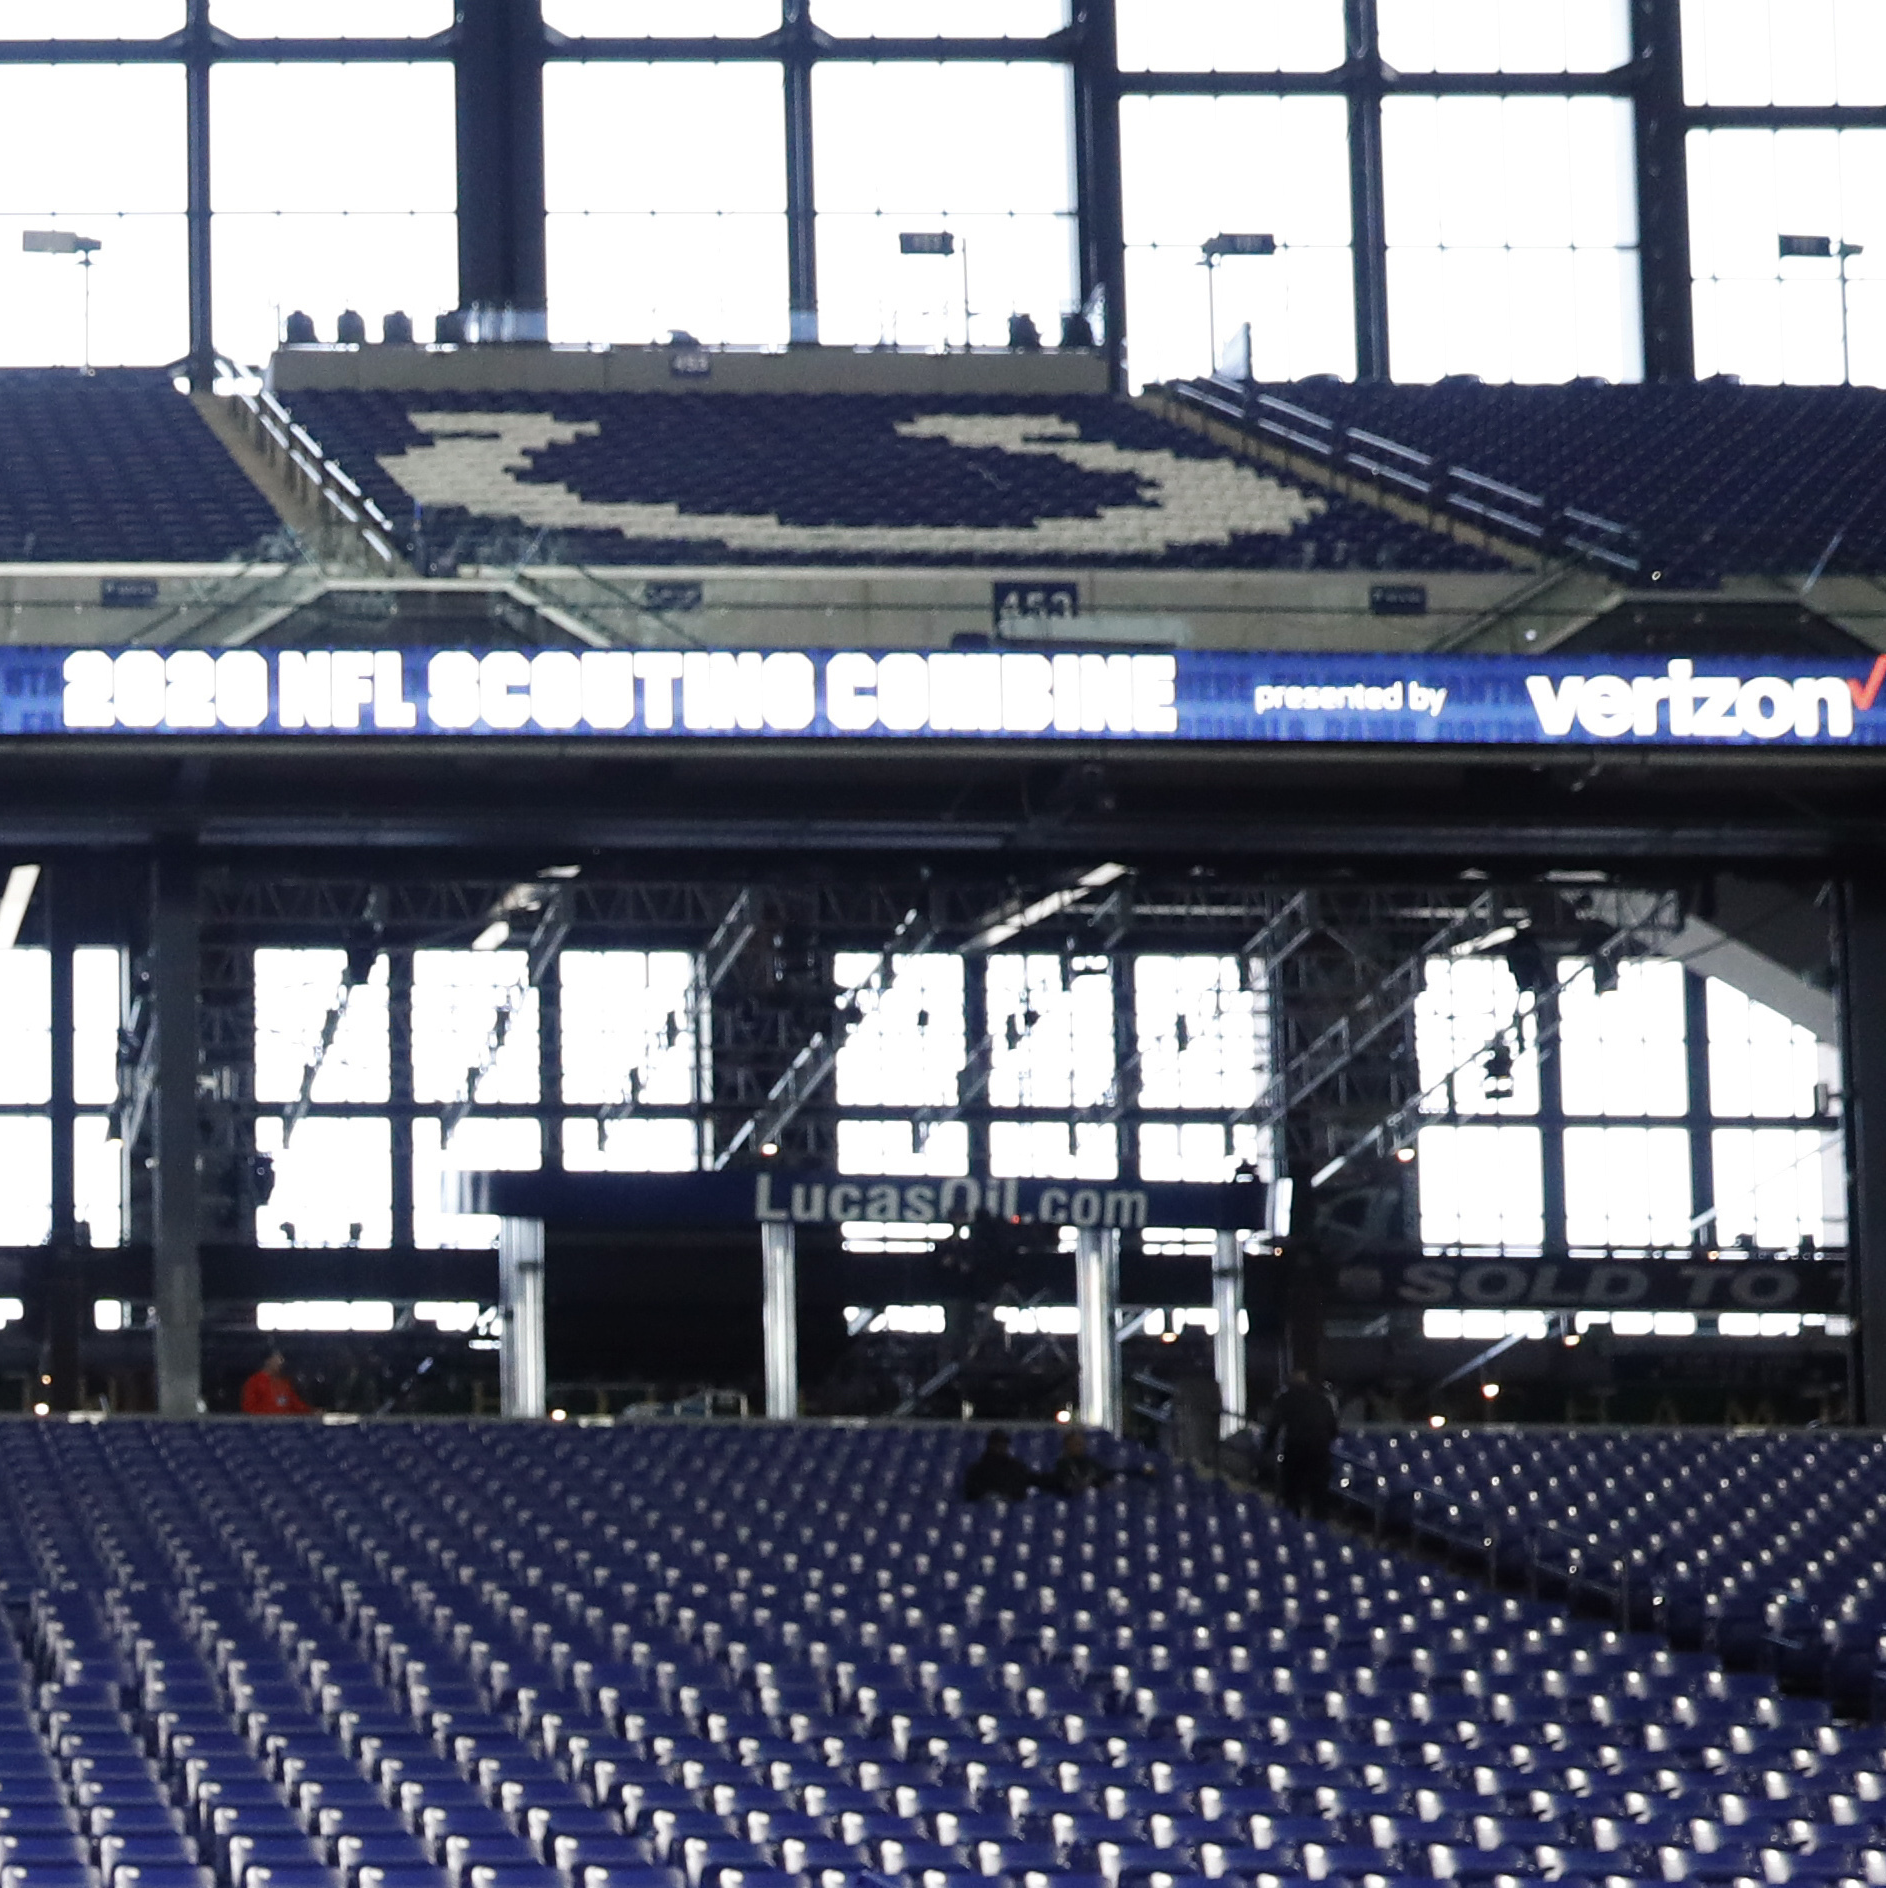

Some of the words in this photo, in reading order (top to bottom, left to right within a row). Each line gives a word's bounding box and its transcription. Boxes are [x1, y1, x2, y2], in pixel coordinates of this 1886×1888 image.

[61, 649, 269, 730] 2020
[277, 649, 419, 730] NFL
[426, 649, 816, 730] SCOUTING
[825, 651, 1179, 733] COMBINE
[1254, 679, 1404, 716] presented
[1407, 681, 1449, 716] by
[1526, 657, 1855, 739] verizon
[754, 1170, 1150, 1228] LucasOil.com
[1394, 1265, 1654, 1302] SOLD
[1682, 1266, 1800, 1303] TO
